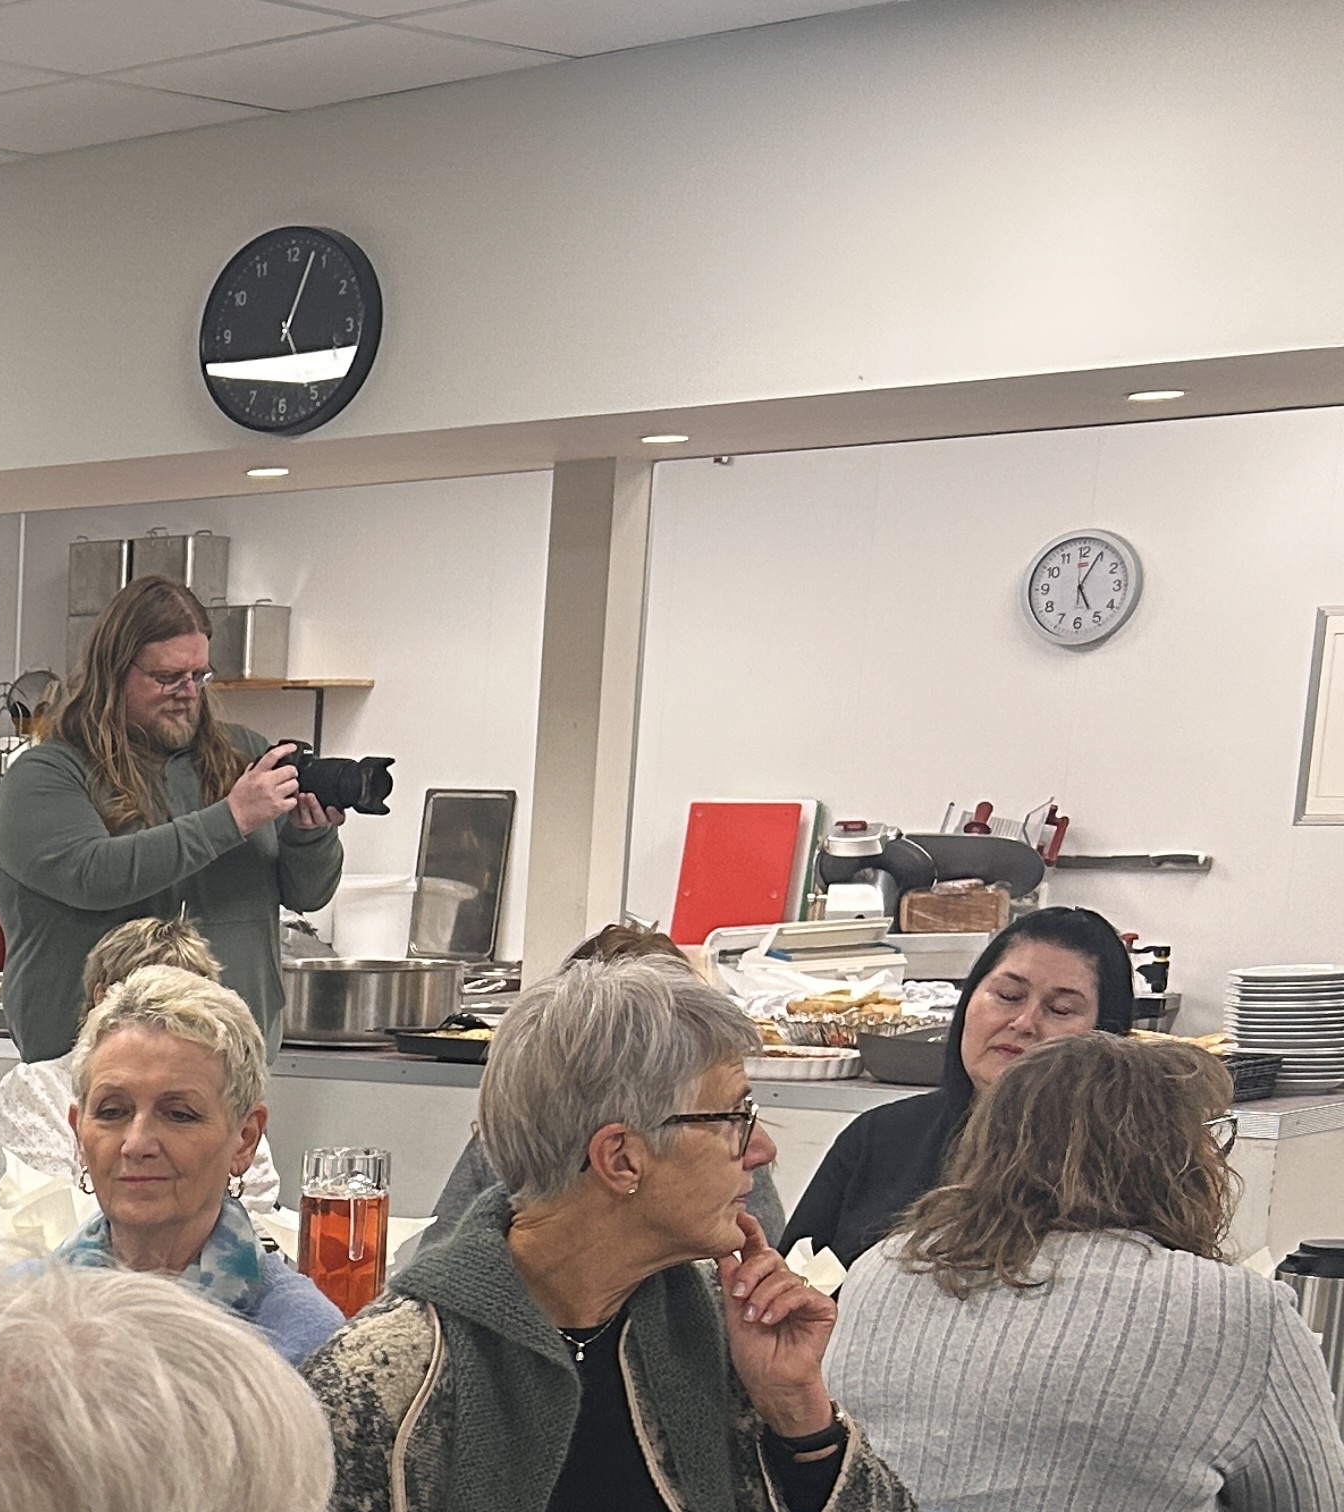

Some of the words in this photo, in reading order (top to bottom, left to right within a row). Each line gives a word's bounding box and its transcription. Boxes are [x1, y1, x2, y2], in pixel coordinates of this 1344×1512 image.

[287, 247, 300, 262] 12
[339, 279, 348, 294] 2
[235, 290, 247, 306] 10
[346, 317, 354, 332] 3
[223, 330, 232, 344] 9
[248, 390, 258, 405] 7
[309, 385, 319, 400] 5
[278, 398, 287, 414] 6
[1061, 553, 1071, 564] 11
[1078, 546, 1092, 558] 12
[1047, 566, 1060, 579] 10
[1109, 562, 1118, 575] 2
[1040, 583, 1050, 595] 9
[1112, 579, 1122, 592] 3
[1044, 600, 1054, 613] 8
[1106, 598, 1116, 610] 4
[1057, 613, 1066, 624] 7
[1073, 617, 1082, 630] 6
[1092, 611, 1102, 624] 5
